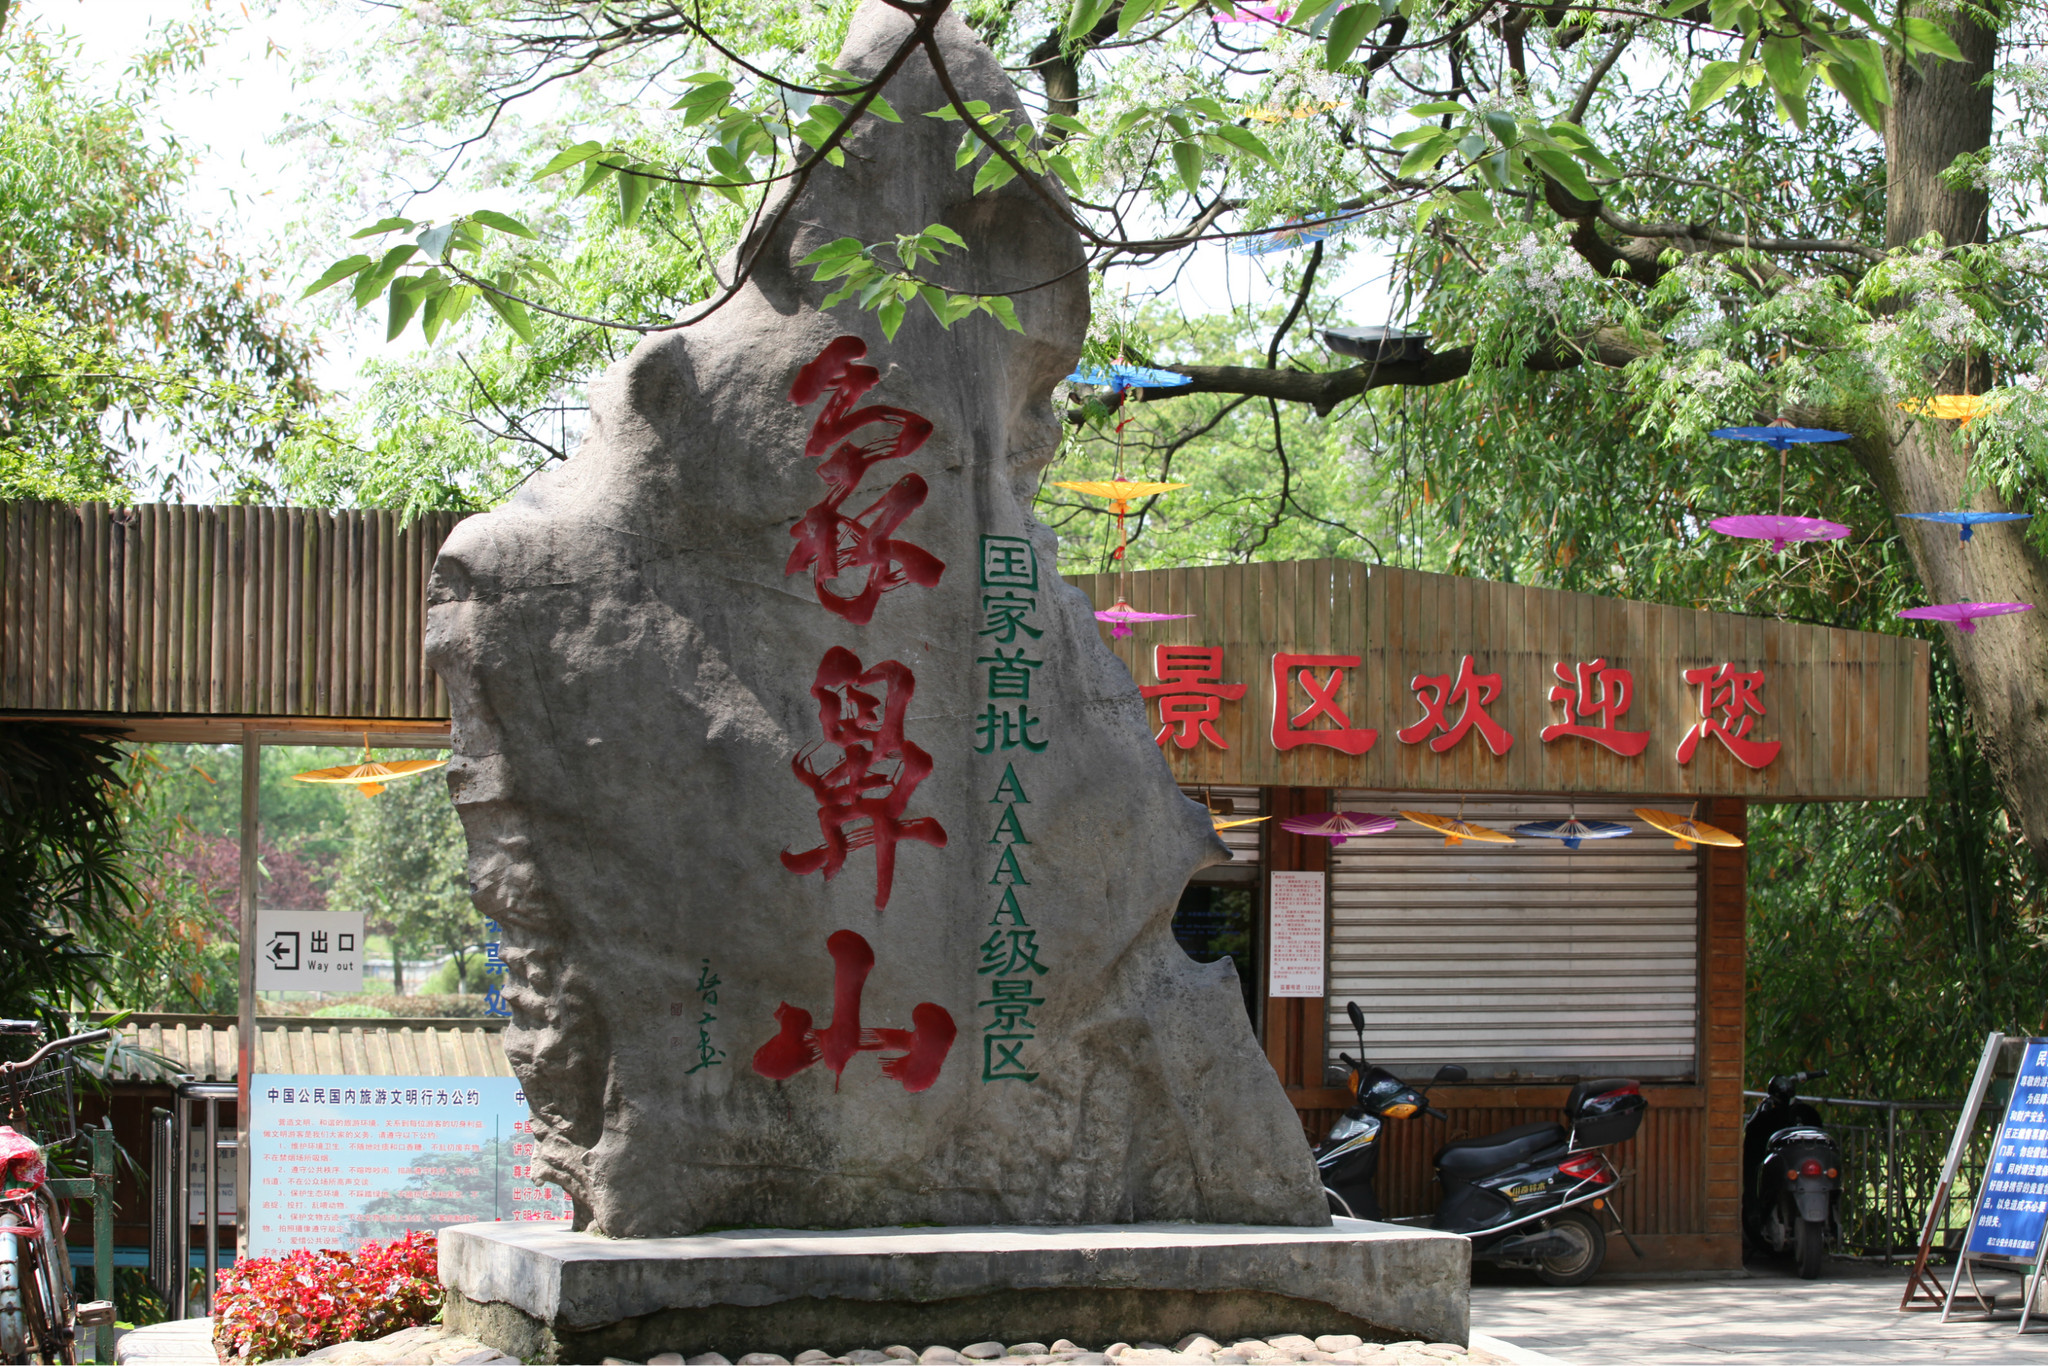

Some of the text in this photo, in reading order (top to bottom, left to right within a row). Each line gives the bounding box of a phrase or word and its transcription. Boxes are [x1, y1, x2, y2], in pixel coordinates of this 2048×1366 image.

[1139, 645, 1782, 769] 景区欢迎您
[974, 533, 1049, 1084] 国家首批AAAA级景区
[310, 930, 355, 954] 出口
[308, 960, 354, 973] Way out
[2035, 1050, 2048, 1067] 民
[267, 1087, 480, 1106] 中国公民国内旅游文明行为公约
[2025, 1093, 2048, 1105] 为保障
